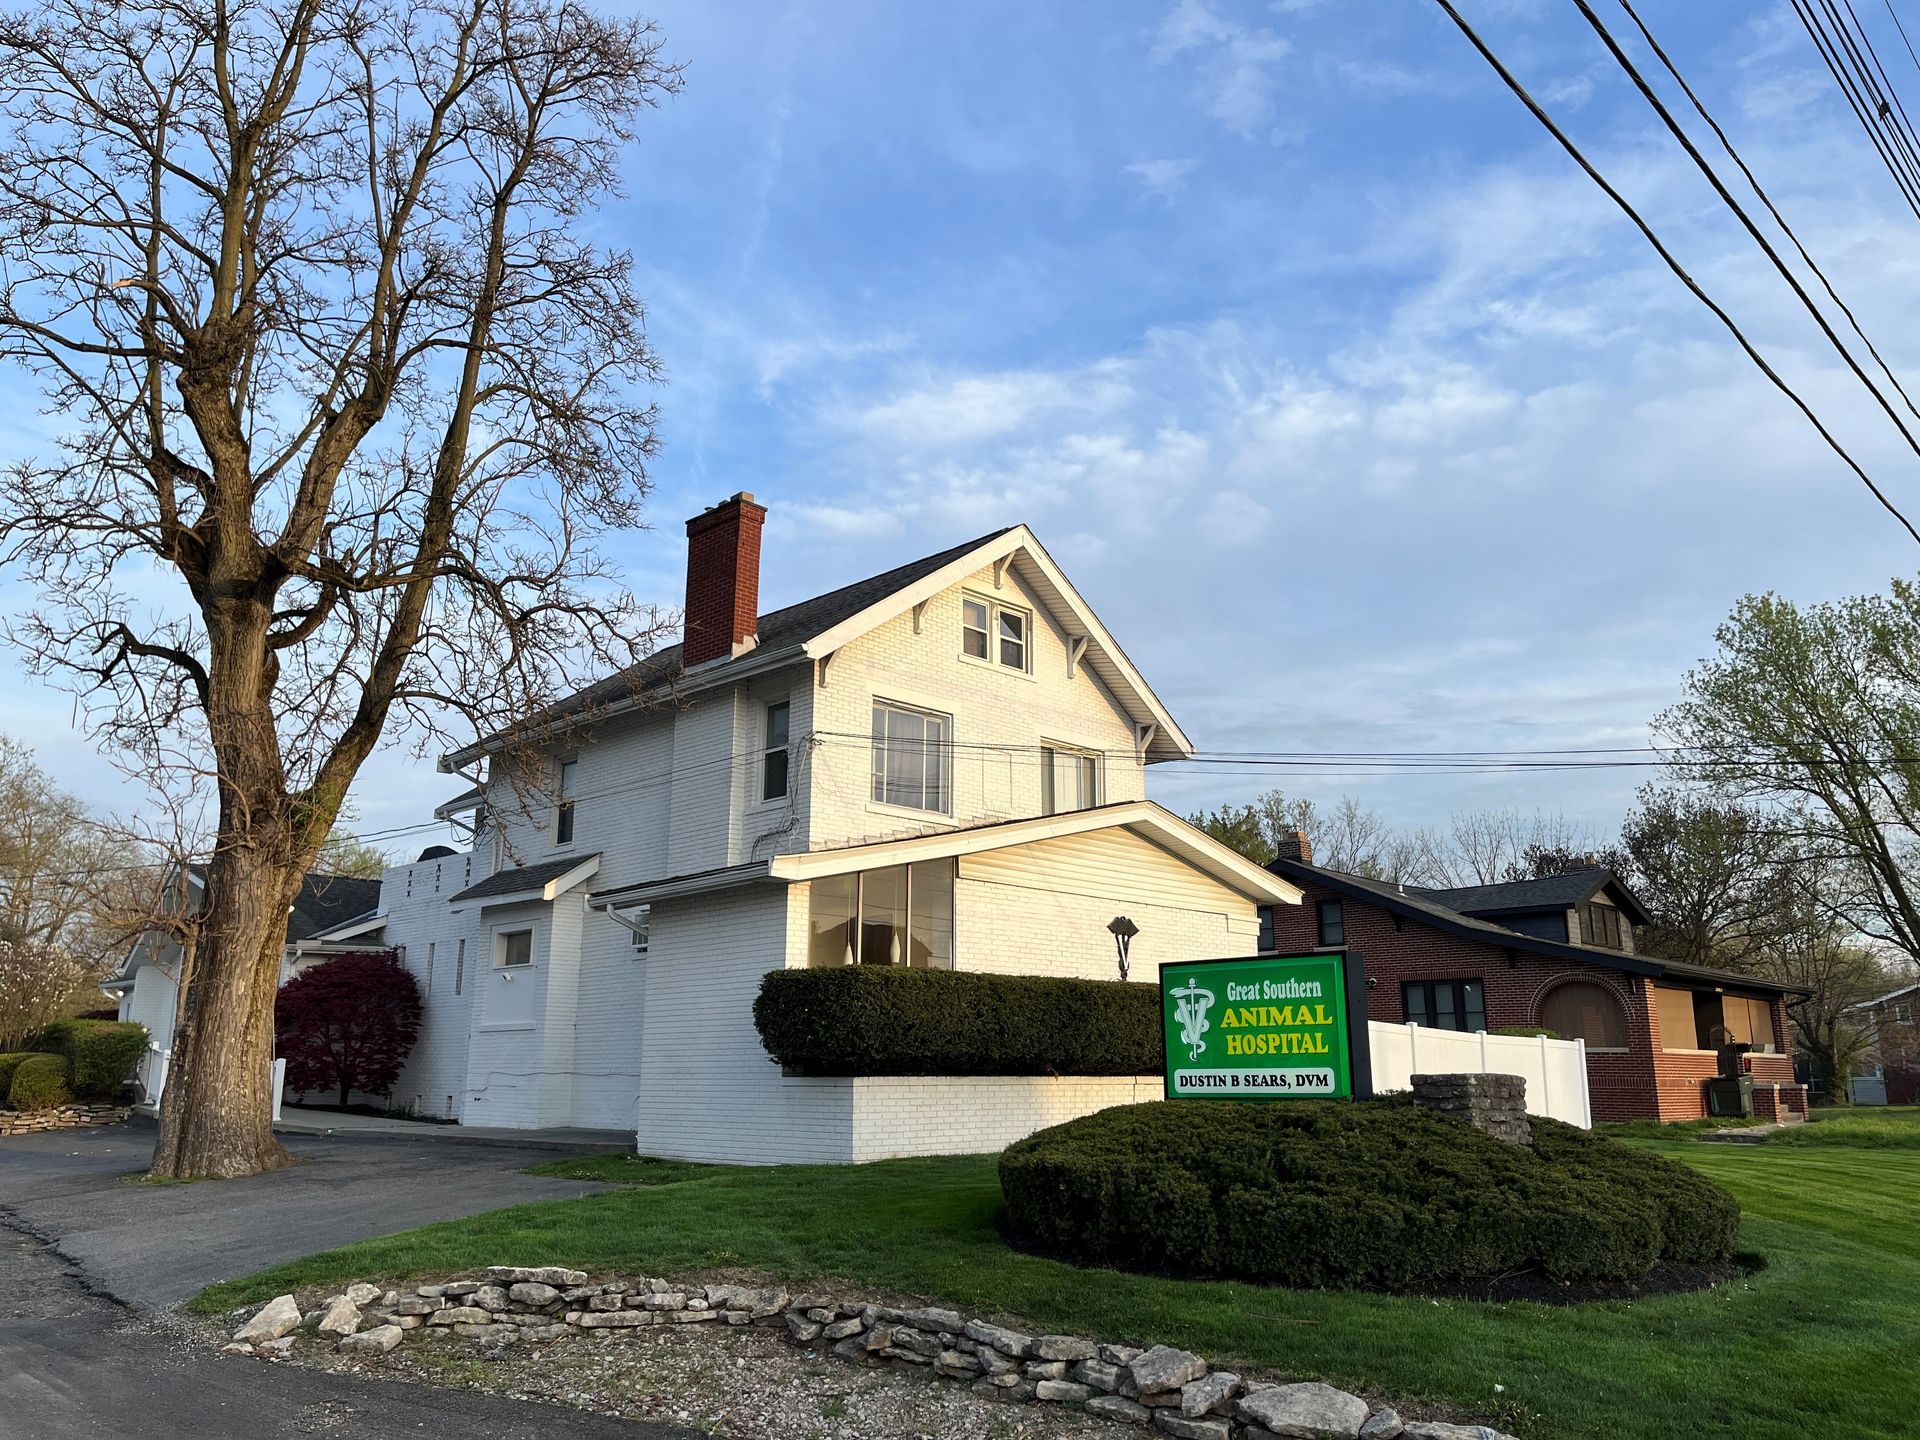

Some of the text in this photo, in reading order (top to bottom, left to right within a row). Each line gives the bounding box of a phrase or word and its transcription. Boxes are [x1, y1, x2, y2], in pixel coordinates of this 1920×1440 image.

[1227, 977, 1322, 1001] Great Southern
[1220, 1004, 1333, 1028] ANIMAL
[1226, 1032, 1329, 1055] HOSPITAL
[1179, 1074, 1329, 1090] DUSTIN B SEARS, DVM
